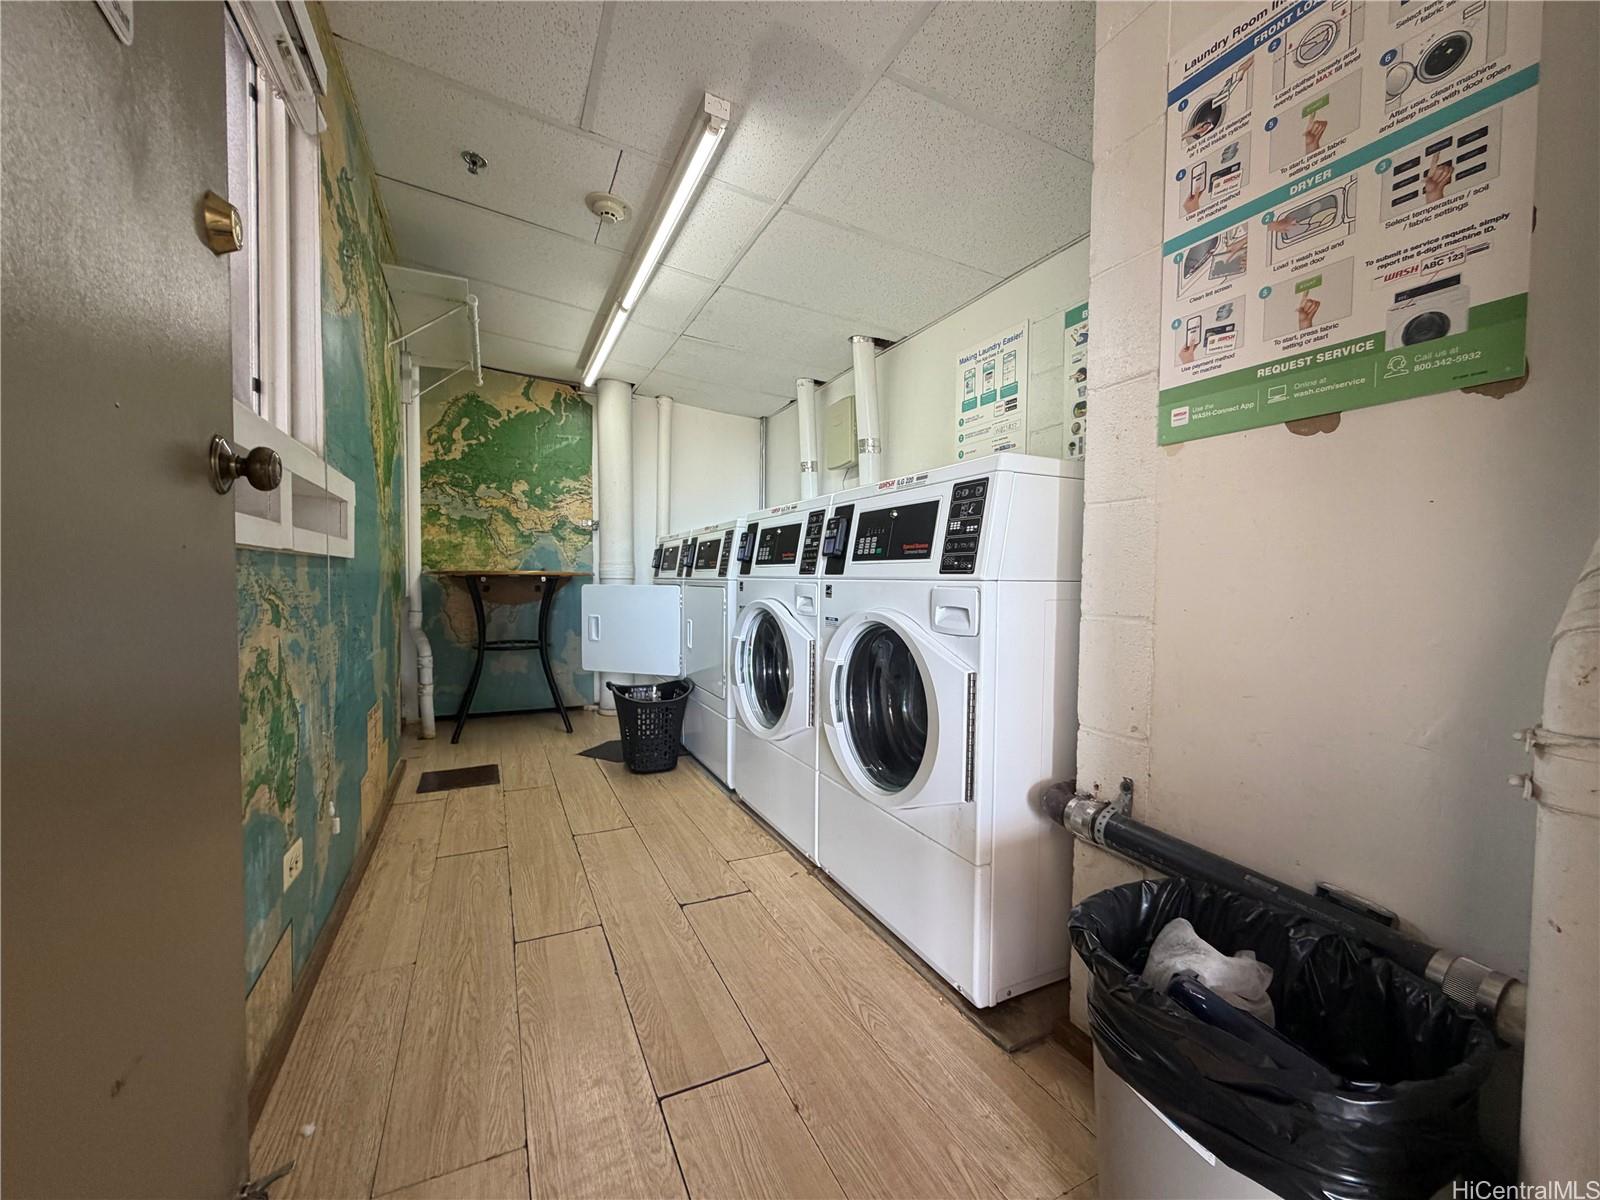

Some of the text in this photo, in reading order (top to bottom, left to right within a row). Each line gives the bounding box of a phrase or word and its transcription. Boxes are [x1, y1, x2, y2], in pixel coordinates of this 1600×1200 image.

[1396, 7, 1422, 29] Select
[1420, 6, 1444, 23] fabric
[1184, 36, 1228, 72] Laundry
[1232, 9, 1268, 38] Room
[1254, 12, 1293, 46] FRONT
[1274, 94, 1294, 109] evenly
[1295, 82, 1314, 96] below
[1316, 70, 1333, 84] MAX
[1344, 54, 1360, 67] level
[1275, 48, 1357, 100] Load clothes loosely and
[1379, 64, 1511, 134] and keep fresh with door open
[1389, 106, 1408, 120] After
[1430, 84, 1454, 99] clean
[1456, 62, 1497, 88] machine
[1186, 144, 1197, 153] Add
[1219, 126, 1224, 134] of
[1225, 112, 1252, 130] detergent
[1211, 134, 1227, 147] inside
[1228, 120, 1250, 138] cylinder
[1306, 149, 1326, 162] press
[1327, 138, 1346, 151] fabric
[1289, 162, 1310, 177] setting
[1320, 151, 1336, 162] start
[1289, 168, 1332, 196] DRYER
[1186, 190, 1240, 222] Use payment method
[1205, 204, 1227, 219] machine
[1385, 215, 1410, 230] Select
[1412, 194, 1465, 218] temperature
[1472, 184, 1489, 195] soil
[1408, 214, 1432, 228] fabric
[1434, 201, 1469, 219] settings
[1376, 250, 1401, 264] submit
[1410, 238, 1440, 252] service
[1442, 224, 1477, 240] request,
[1479, 212, 1510, 227] simply
[1377, 258, 1400, 270] report
[1402, 252, 1414, 262] the
[1416, 242, 1442, 257] 6-digit
[1444, 231, 1482, 248] machine
[1273, 262, 1289, 272] Load
[1296, 252, 1313, 263] wash
[1314, 246, 1329, 256] load
[1330, 240, 1344, 250] and
[1291, 256, 1325, 272] close door
[1383, 264, 1419, 282] WASH
[1422, 259, 1444, 271] ABC
[1447, 252, 1464, 263] 123
[1189, 284, 1232, 303] Clean lint screen
[1282, 340, 1303, 351] setting
[1313, 334, 1328, 343] start
[1300, 329, 1318, 340] press
[1320, 322, 1339, 333] fabric
[960, 330, 1023, 365] Making Laundry Easier!
[1192, 359, 1214, 370] payment
[1214, 352, 1235, 364] method
[1257, 340, 1375, 378] REQUEST SERVICE
[1414, 352, 1432, 362] Call
[1435, 348, 1447, 357] us
[1200, 364, 1222, 373] machine
[1414, 351, 1482, 372] 800.342-5932
[1293, 377, 1365, 398] wash.com/service
[1294, 379, 1317, 390] Online
[1192, 402, 1254, 420] WASH-Connect App
